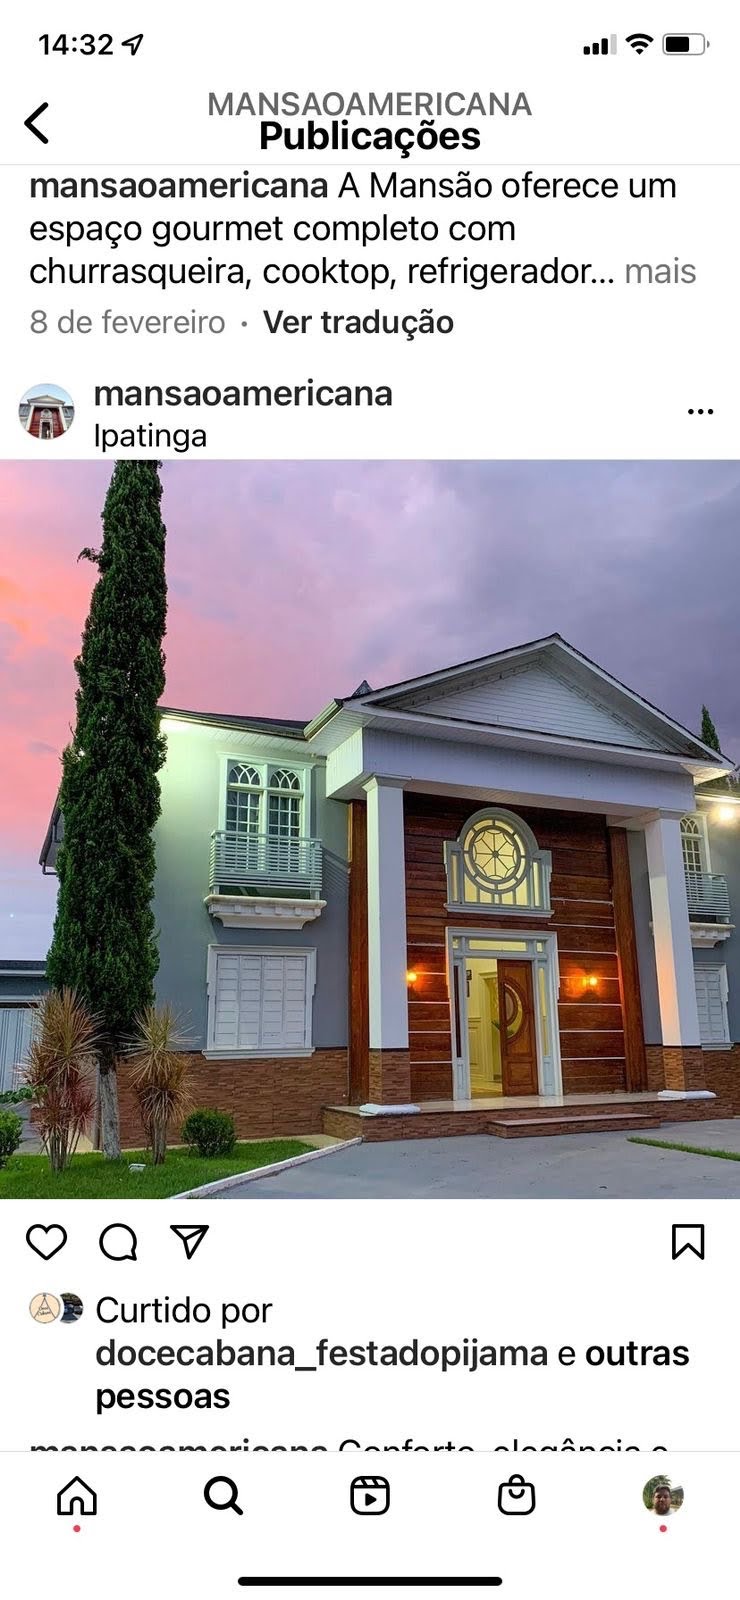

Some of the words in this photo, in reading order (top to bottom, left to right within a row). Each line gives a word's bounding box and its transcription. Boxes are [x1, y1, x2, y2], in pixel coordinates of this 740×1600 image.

[39, 34, 113, 56] 14:32
[208, 92, 532, 116] MANSAOAMERICANA
[260, 119, 481, 159] Publicações
[30, 170, 328, 199] mansaoamericana
[338, 172, 360, 198] A
[370, 171, 493, 199] Mansão
[501, 170, 619, 199] oferece
[629, 177, 677, 199] um
[29, 220, 142, 249] espaço
[152, 215, 284, 249] gourmet
[293, 213, 439, 249] completo
[448, 220, 516, 242] com
[29, 256, 251, 291] churrasqueira,
[262, 256, 397, 291] cooktop,
[408, 256, 614, 291] refrigerador...
[625, 257, 697, 285] mais
[30, 309, 48, 334] 8
[57, 309, 93, 334] de
[101, 308, 226, 334] fevereiro
[262, 309, 313, 334] Ver
[321, 307, 454, 342] tradução
[94, 378, 393, 407] mansaoamericana
[95, 421, 207, 453] Ipatinga
[95, 1295, 211, 1324] Curtido
[221, 1302, 273, 1331] por
[95, 1338, 548, 1373] docecabana_festadopijama
[557, 1345, 576, 1367] e
[585, 1340, 690, 1367] outras
[96, 1387, 231, 1415] pessoas
